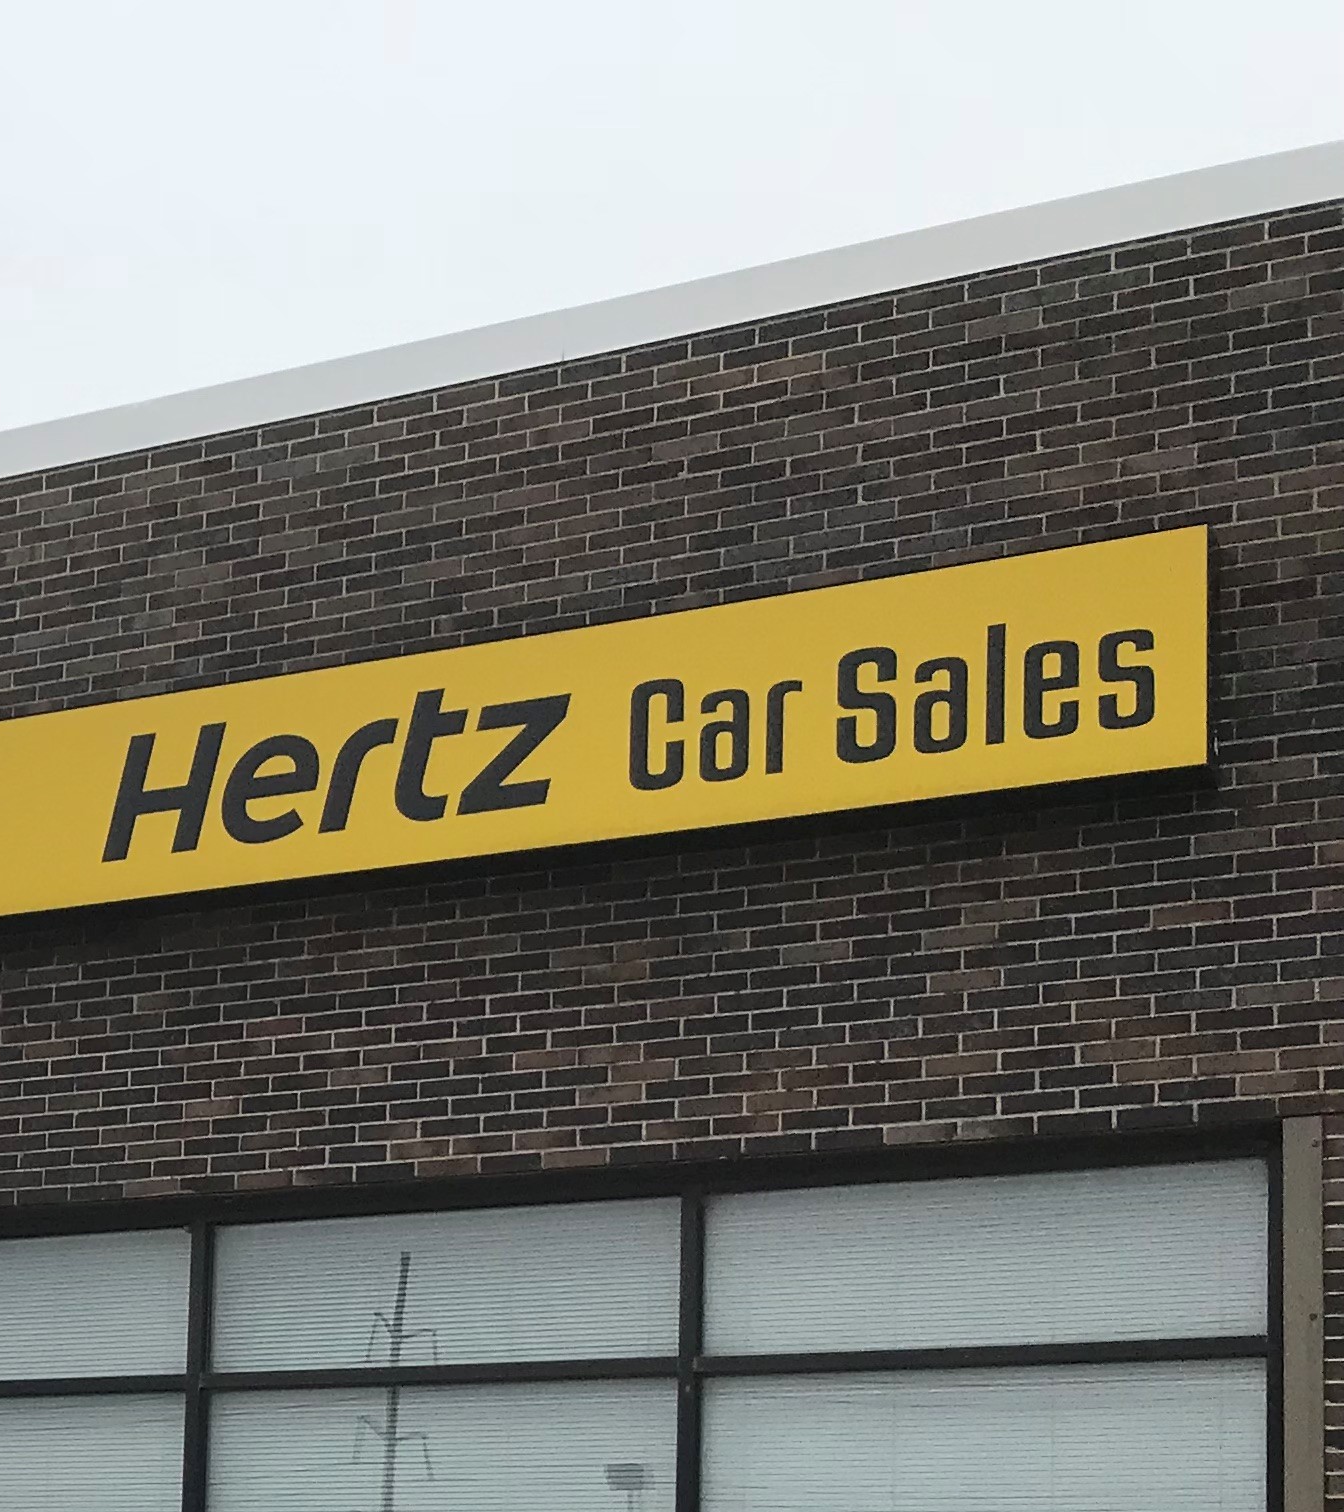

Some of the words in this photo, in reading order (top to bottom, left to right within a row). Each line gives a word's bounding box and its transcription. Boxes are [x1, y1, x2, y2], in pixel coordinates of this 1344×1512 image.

[102, 687, 571, 863] Hertz
[629, 677, 802, 791] Car
[835, 623, 1156, 764] Sales
